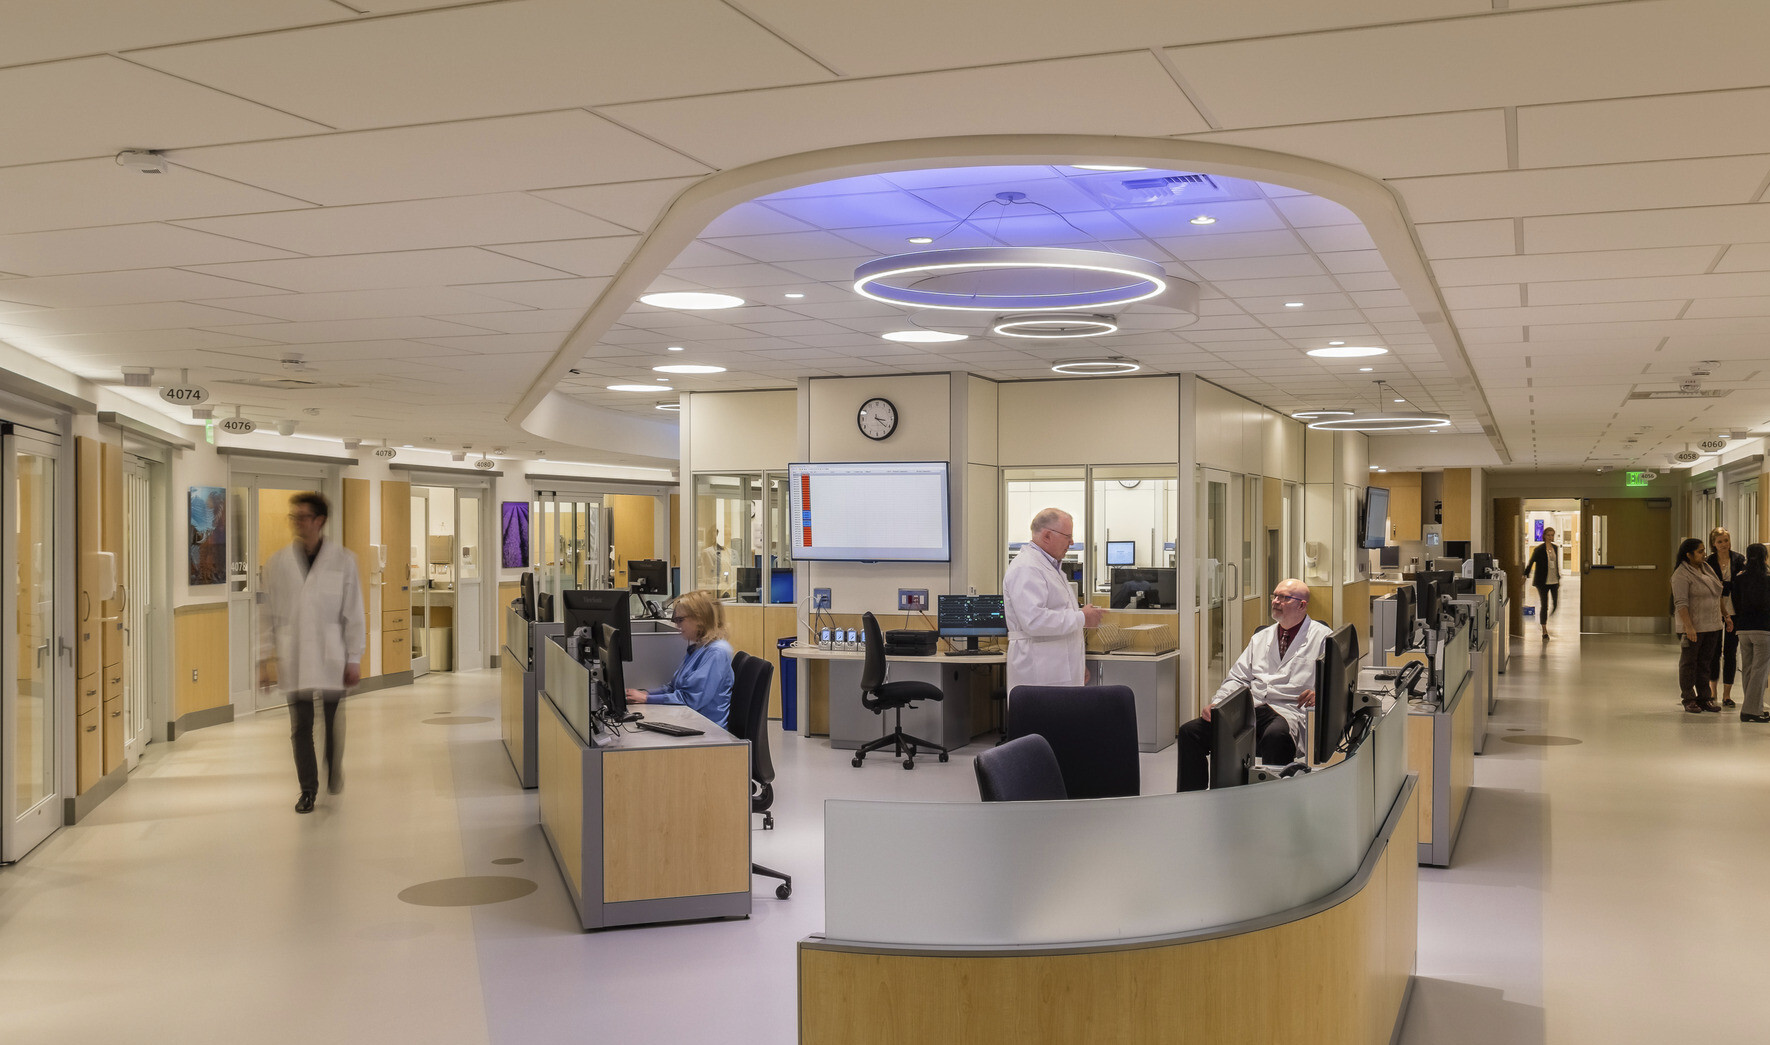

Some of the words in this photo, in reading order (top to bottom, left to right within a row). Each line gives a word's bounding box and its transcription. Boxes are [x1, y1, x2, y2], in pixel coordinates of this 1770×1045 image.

[166, 388, 201, 400] 4074
[224, 421, 251, 431] 4076
[1701, 440, 1723, 448] 4060
